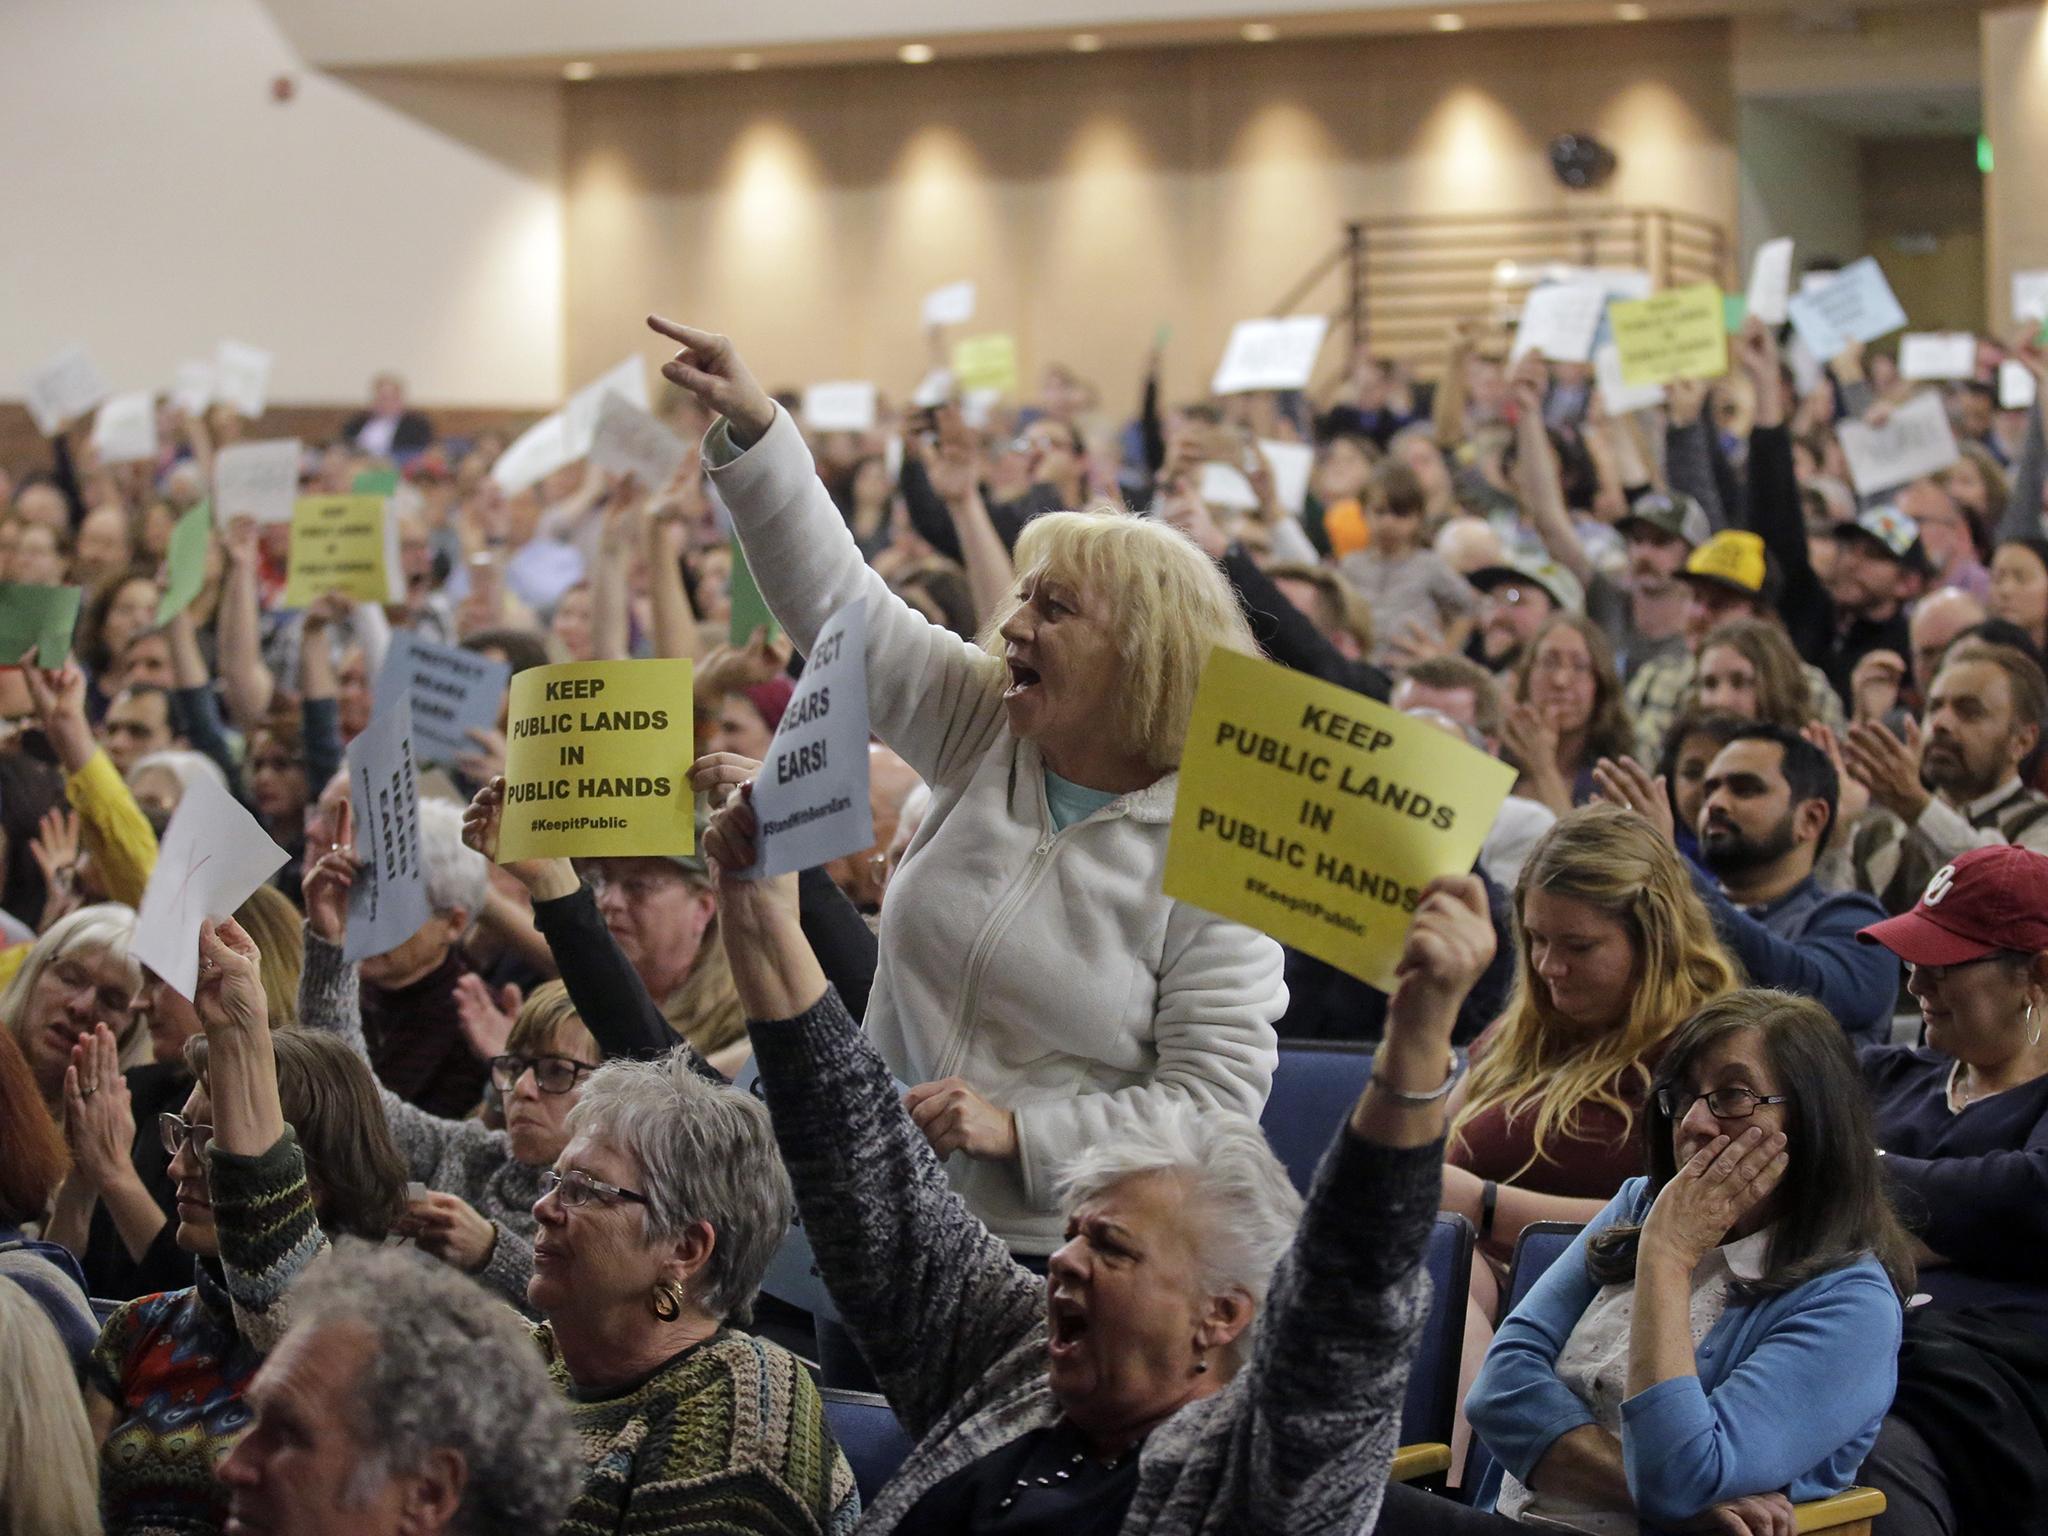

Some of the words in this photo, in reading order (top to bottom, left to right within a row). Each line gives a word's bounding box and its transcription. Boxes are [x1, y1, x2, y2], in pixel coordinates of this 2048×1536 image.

[546, 679, 605, 701] KEEP
[513, 713, 573, 740] PUBLIC
[580, 710, 669, 732] LANDS
[1301, 704, 1395, 753] KEEP
[560, 746, 584, 765] IN
[777, 739, 828, 786] EARS!
[1215, 722, 1331, 783] PUBLIC
[1339, 767, 1456, 831] LANDS
[507, 779, 570, 805] PUBLIC
[577, 776, 671, 798] HANDS
[380, 789, 396, 882] EARS!
[392, 770, 407, 876] BEARS
[531, 816, 628, 832] #KeepitPublic
[1299, 799, 1335, 834] IN
[1197, 807, 1306, 869] PUBLIC
[1315, 853, 1424, 915] HANDS
[1245, 877, 1368, 938] #KeepitPublic
